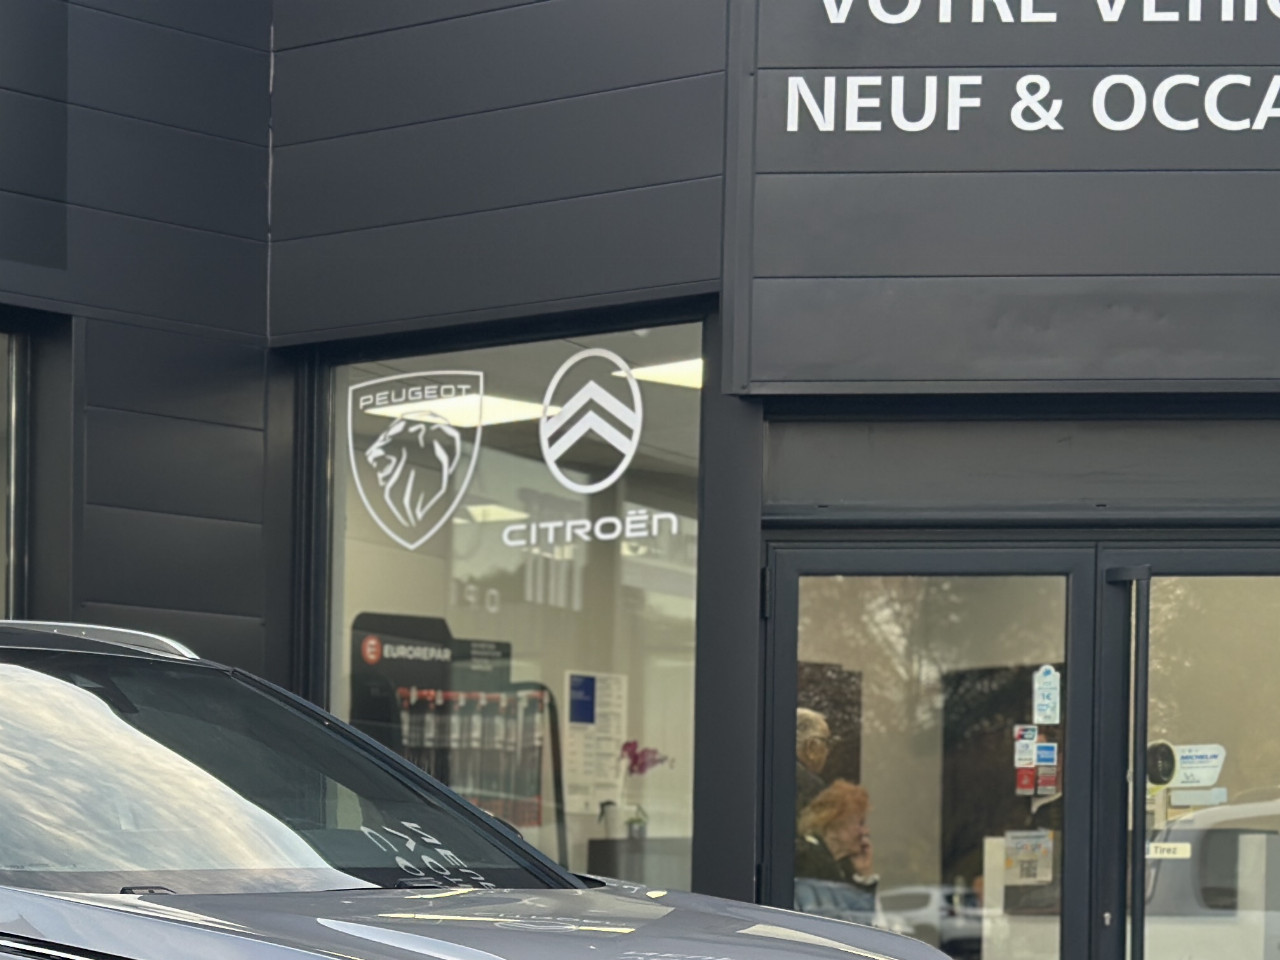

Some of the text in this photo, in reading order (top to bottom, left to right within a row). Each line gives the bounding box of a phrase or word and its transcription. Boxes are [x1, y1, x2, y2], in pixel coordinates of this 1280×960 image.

[786, 75, 983, 132] NEUF
[1010, 74, 1064, 131] &
[359, 384, 471, 409] PEUGEOT
[382, 643, 453, 662] EUROREPAR
[1153, 846, 1178, 855] Tirez
